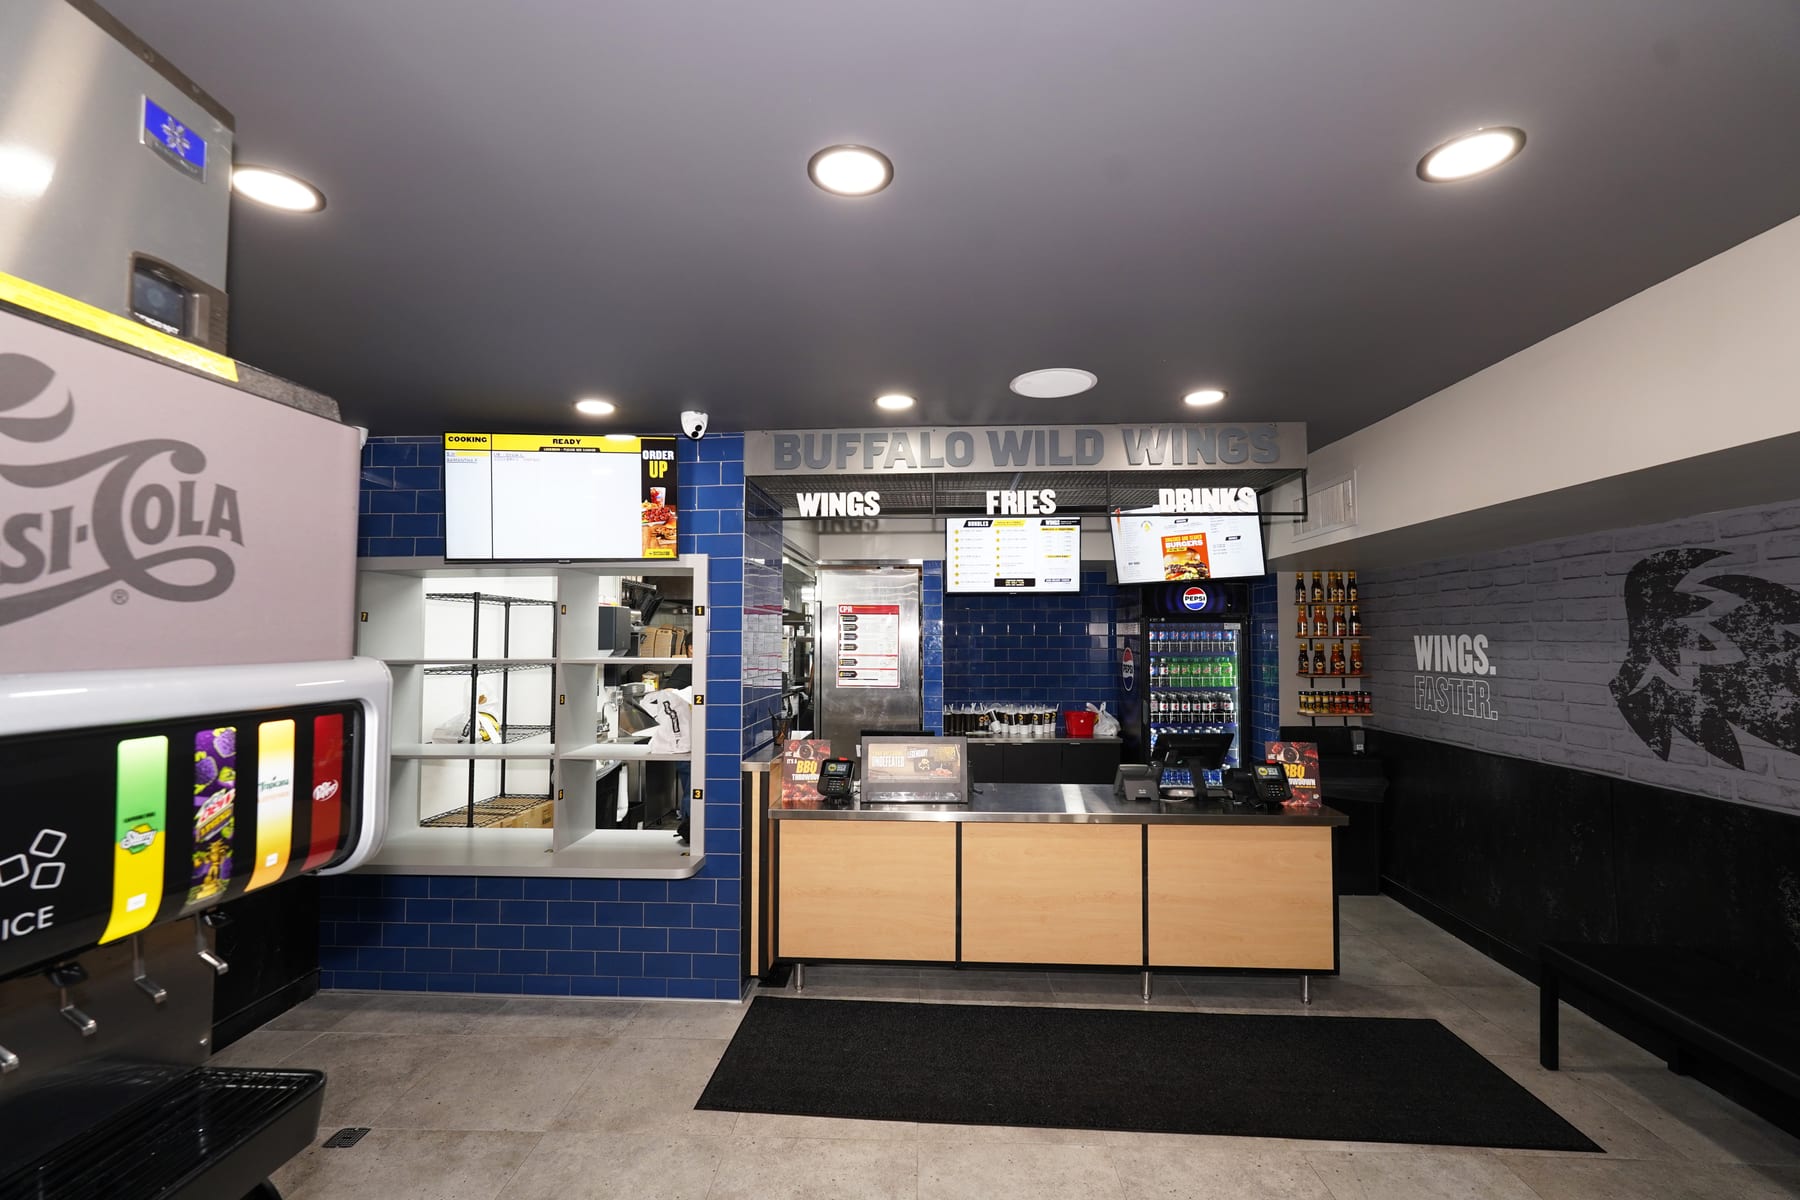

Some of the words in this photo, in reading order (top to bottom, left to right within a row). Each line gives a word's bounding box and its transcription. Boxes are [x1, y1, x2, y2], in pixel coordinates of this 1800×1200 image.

[642, 450, 675, 461] ORDER
[773, 430, 974, 469] BUFFALO
[986, 429, 1104, 467] WILD
[1121, 426, 1281, 466] WINGS
[649, 461, 668, 479] UP
[796, 490, 881, 517] WINGS
[986, 489, 1057, 515] FRIES
[1159, 487, 1256, 512] DRINKS
[1165, 540, 1203, 548] BURGERS
[1413, 634, 1497, 675] WINGS.
[1414, 675, 1498, 720] FASTER.
[796, 760, 817, 774] BBQ
[2, 905, 55, 940] ICE
